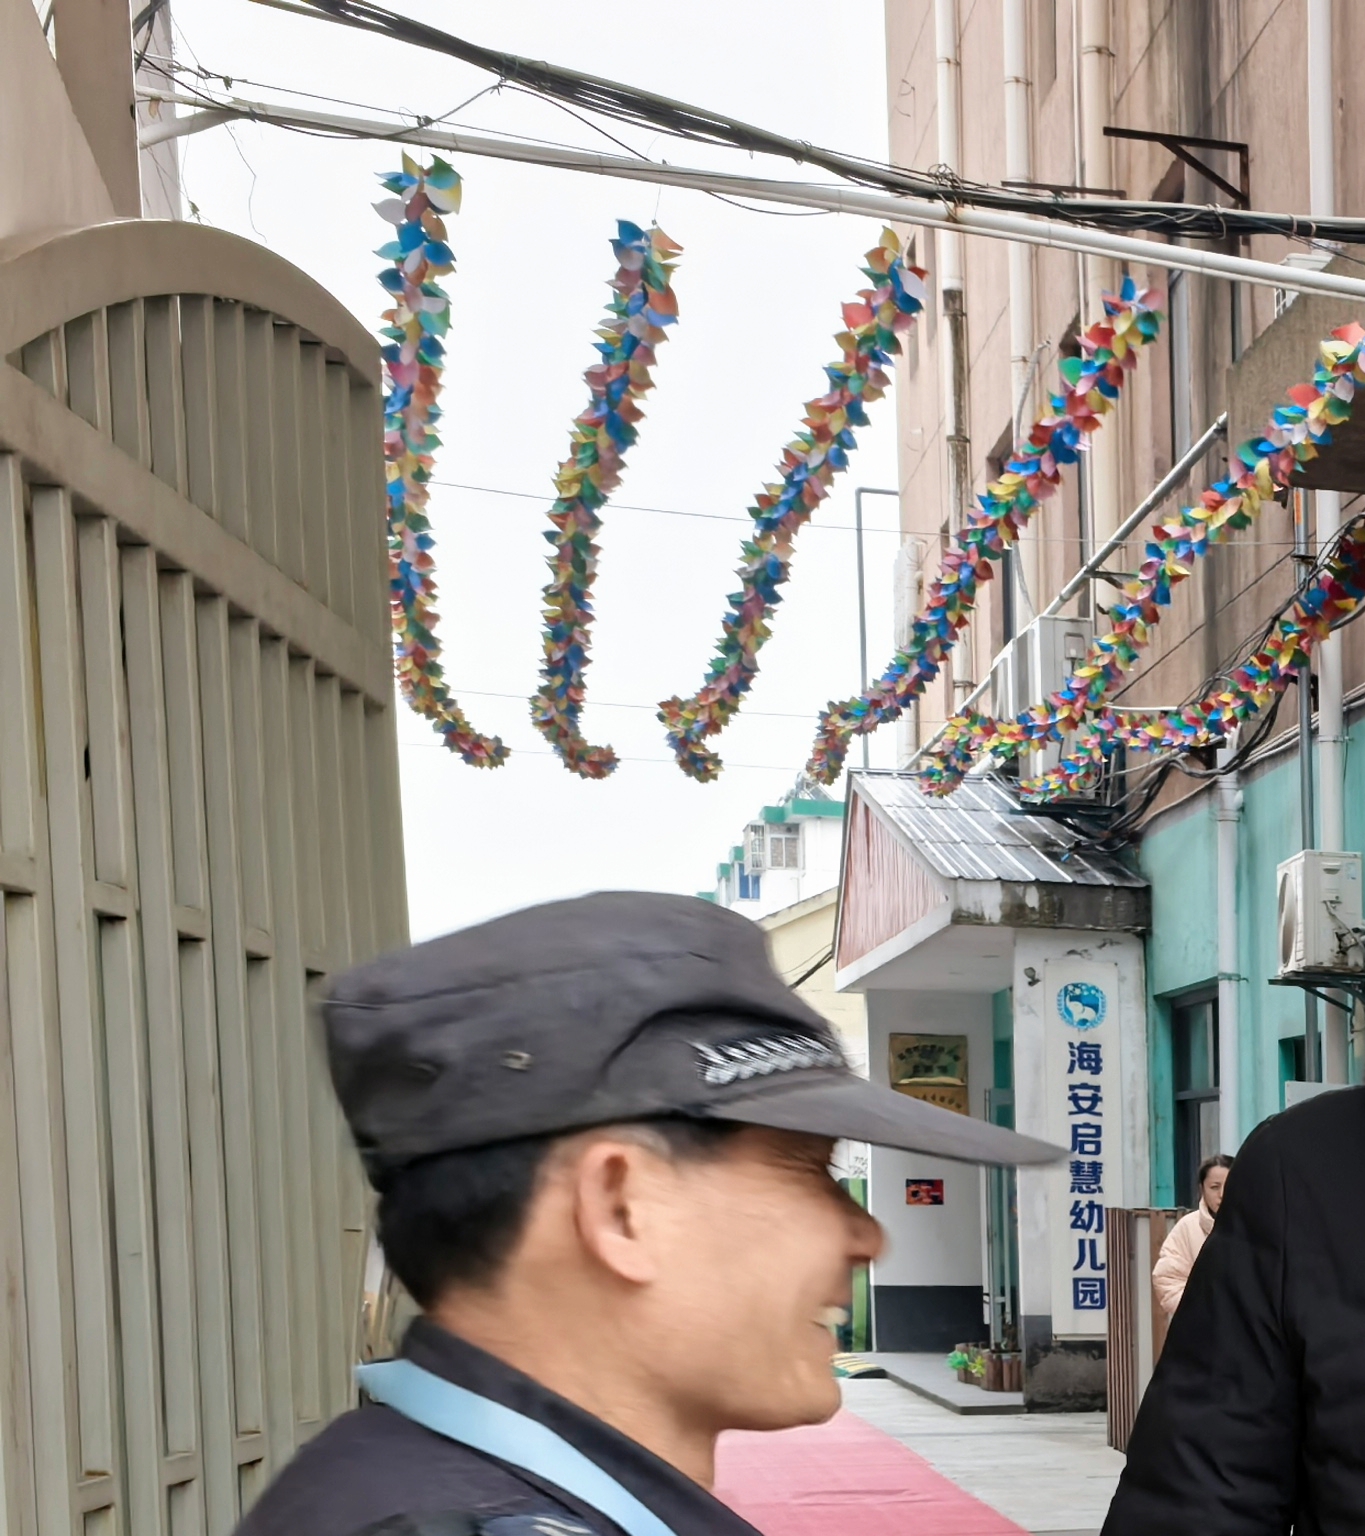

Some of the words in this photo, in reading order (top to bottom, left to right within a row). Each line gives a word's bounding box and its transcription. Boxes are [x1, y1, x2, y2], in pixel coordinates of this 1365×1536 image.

[1067, 1041, 1107, 1311] 海安启慧幼儿园
